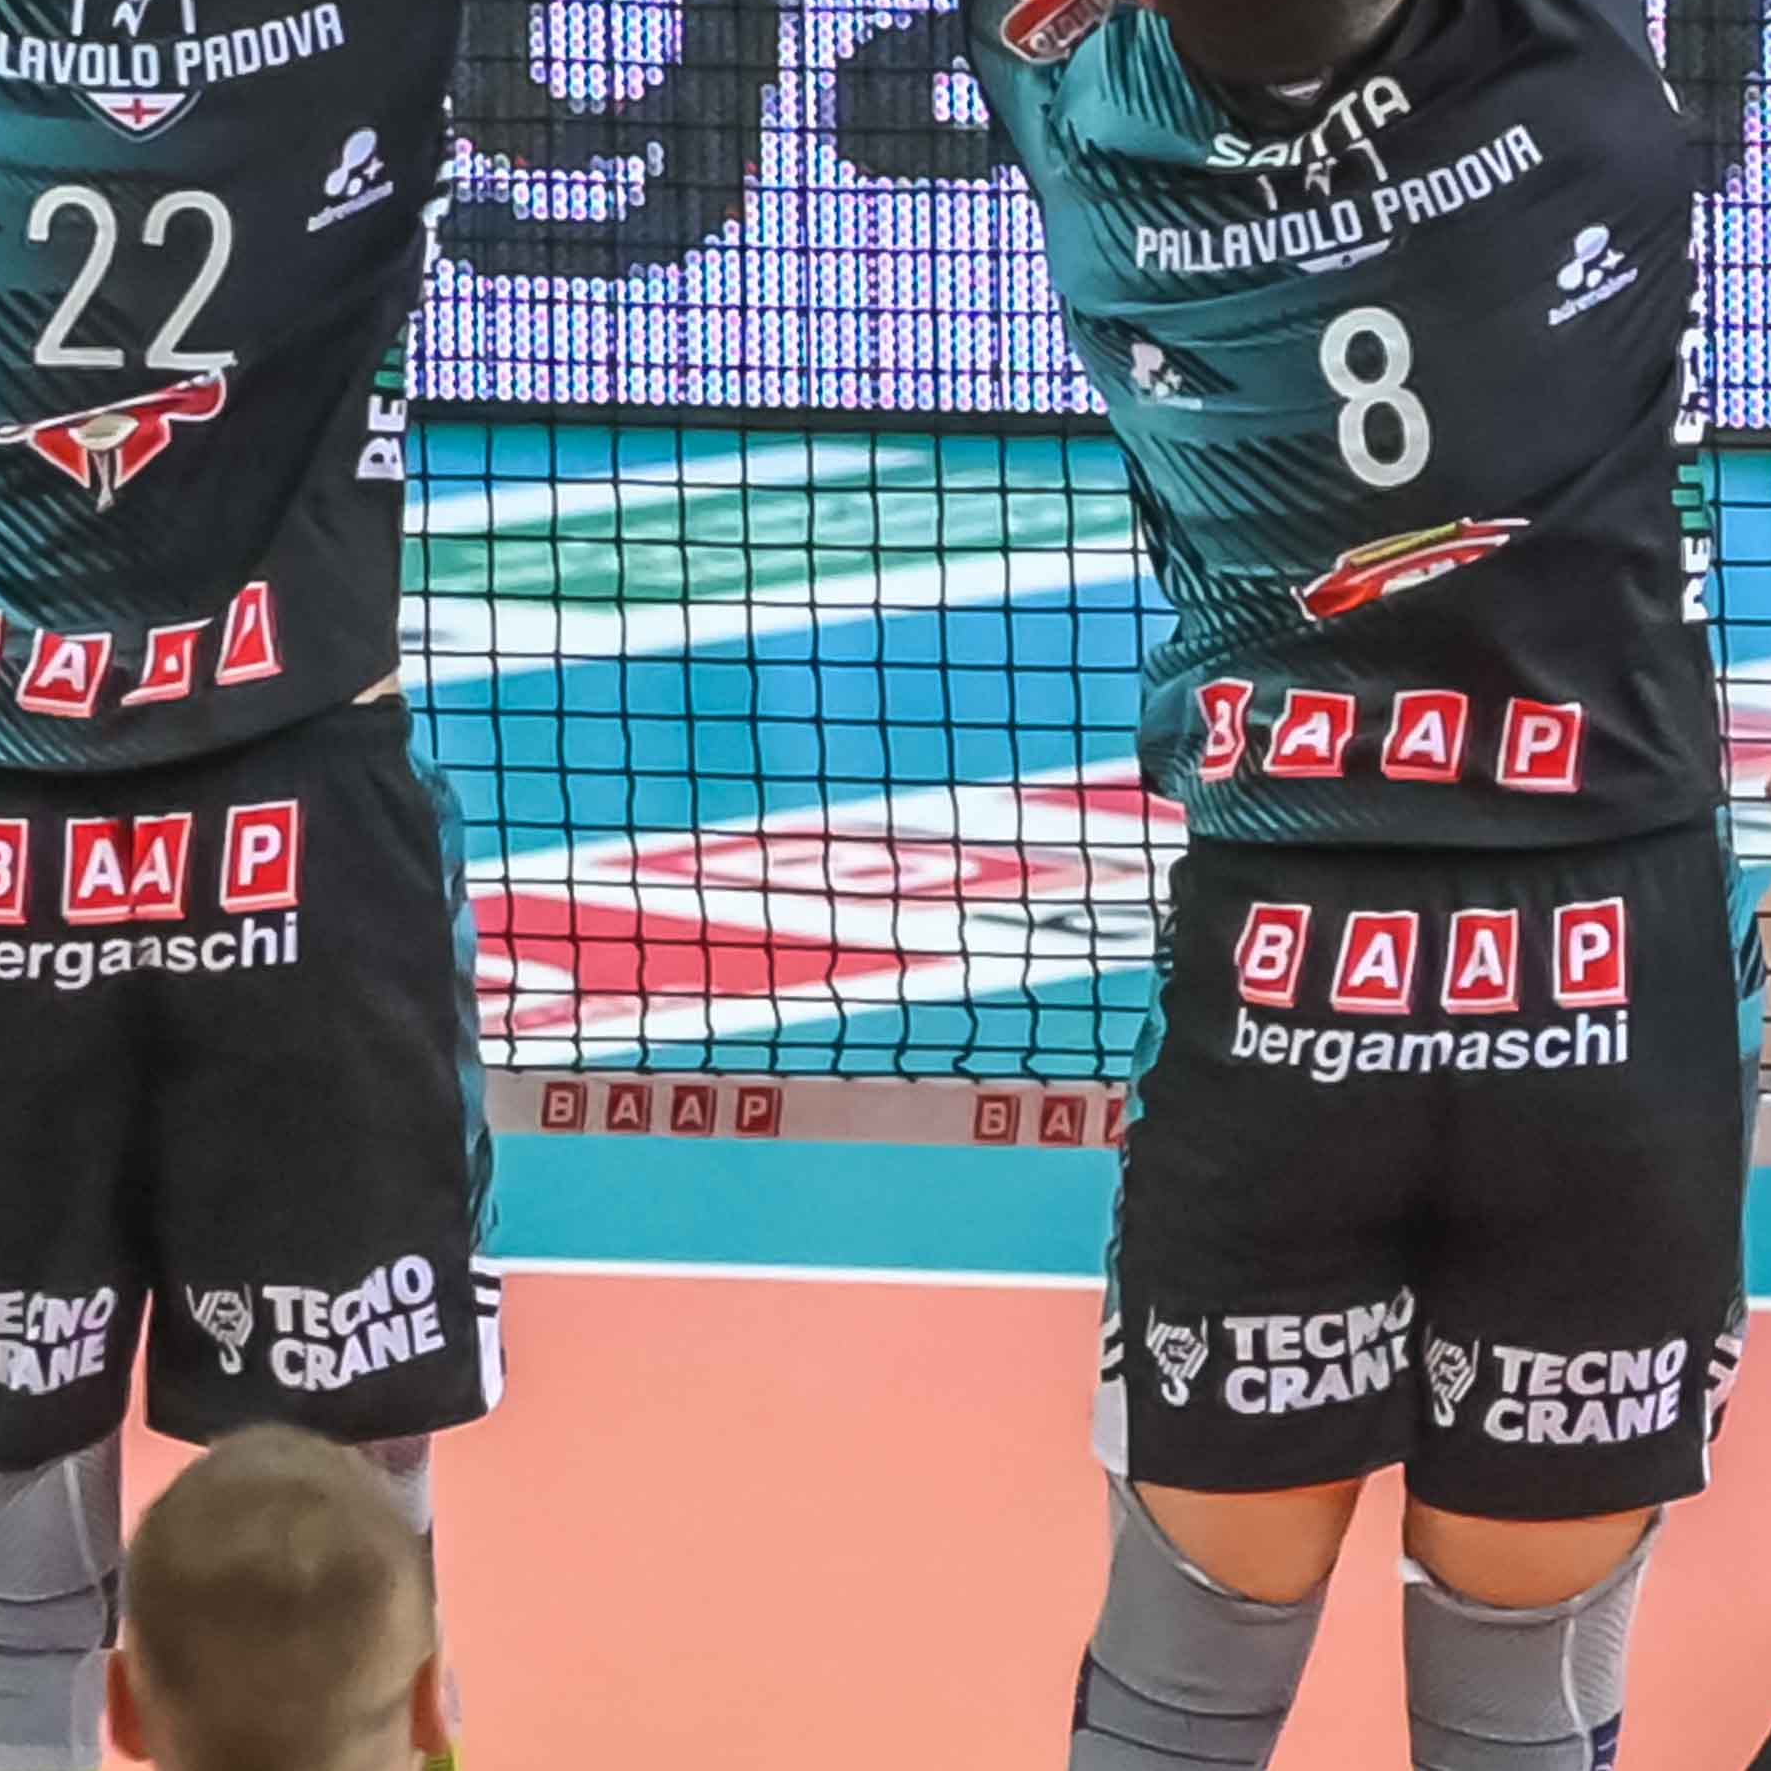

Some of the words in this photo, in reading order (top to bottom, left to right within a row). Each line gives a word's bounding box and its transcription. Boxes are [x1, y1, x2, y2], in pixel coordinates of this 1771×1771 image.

[177, 3, 345, 86] PADOVA
[1135, 200, 1364, 271] PALLAVOLO
[1373, 124, 1544, 233] PADOVA
[29, 185, 237, 370] 22
[1320, 307, 1430, 488] 8
[1202, 690, 1572, 781] BAAP
[1240, 910, 1619, 1000] BAAP
[1231, 1010, 1627, 1082] bergamaschi
[544, 1086, 774, 1132] BAAP
[261, 1254, 437, 1336] TECNO
[1223, 1285, 1416, 1362] TECNO
[270, 1304, 445, 1391] CRANE
[1492, 1338, 1689, 1396] TECNO
[1483, 1388, 1681, 1445] CRANE
